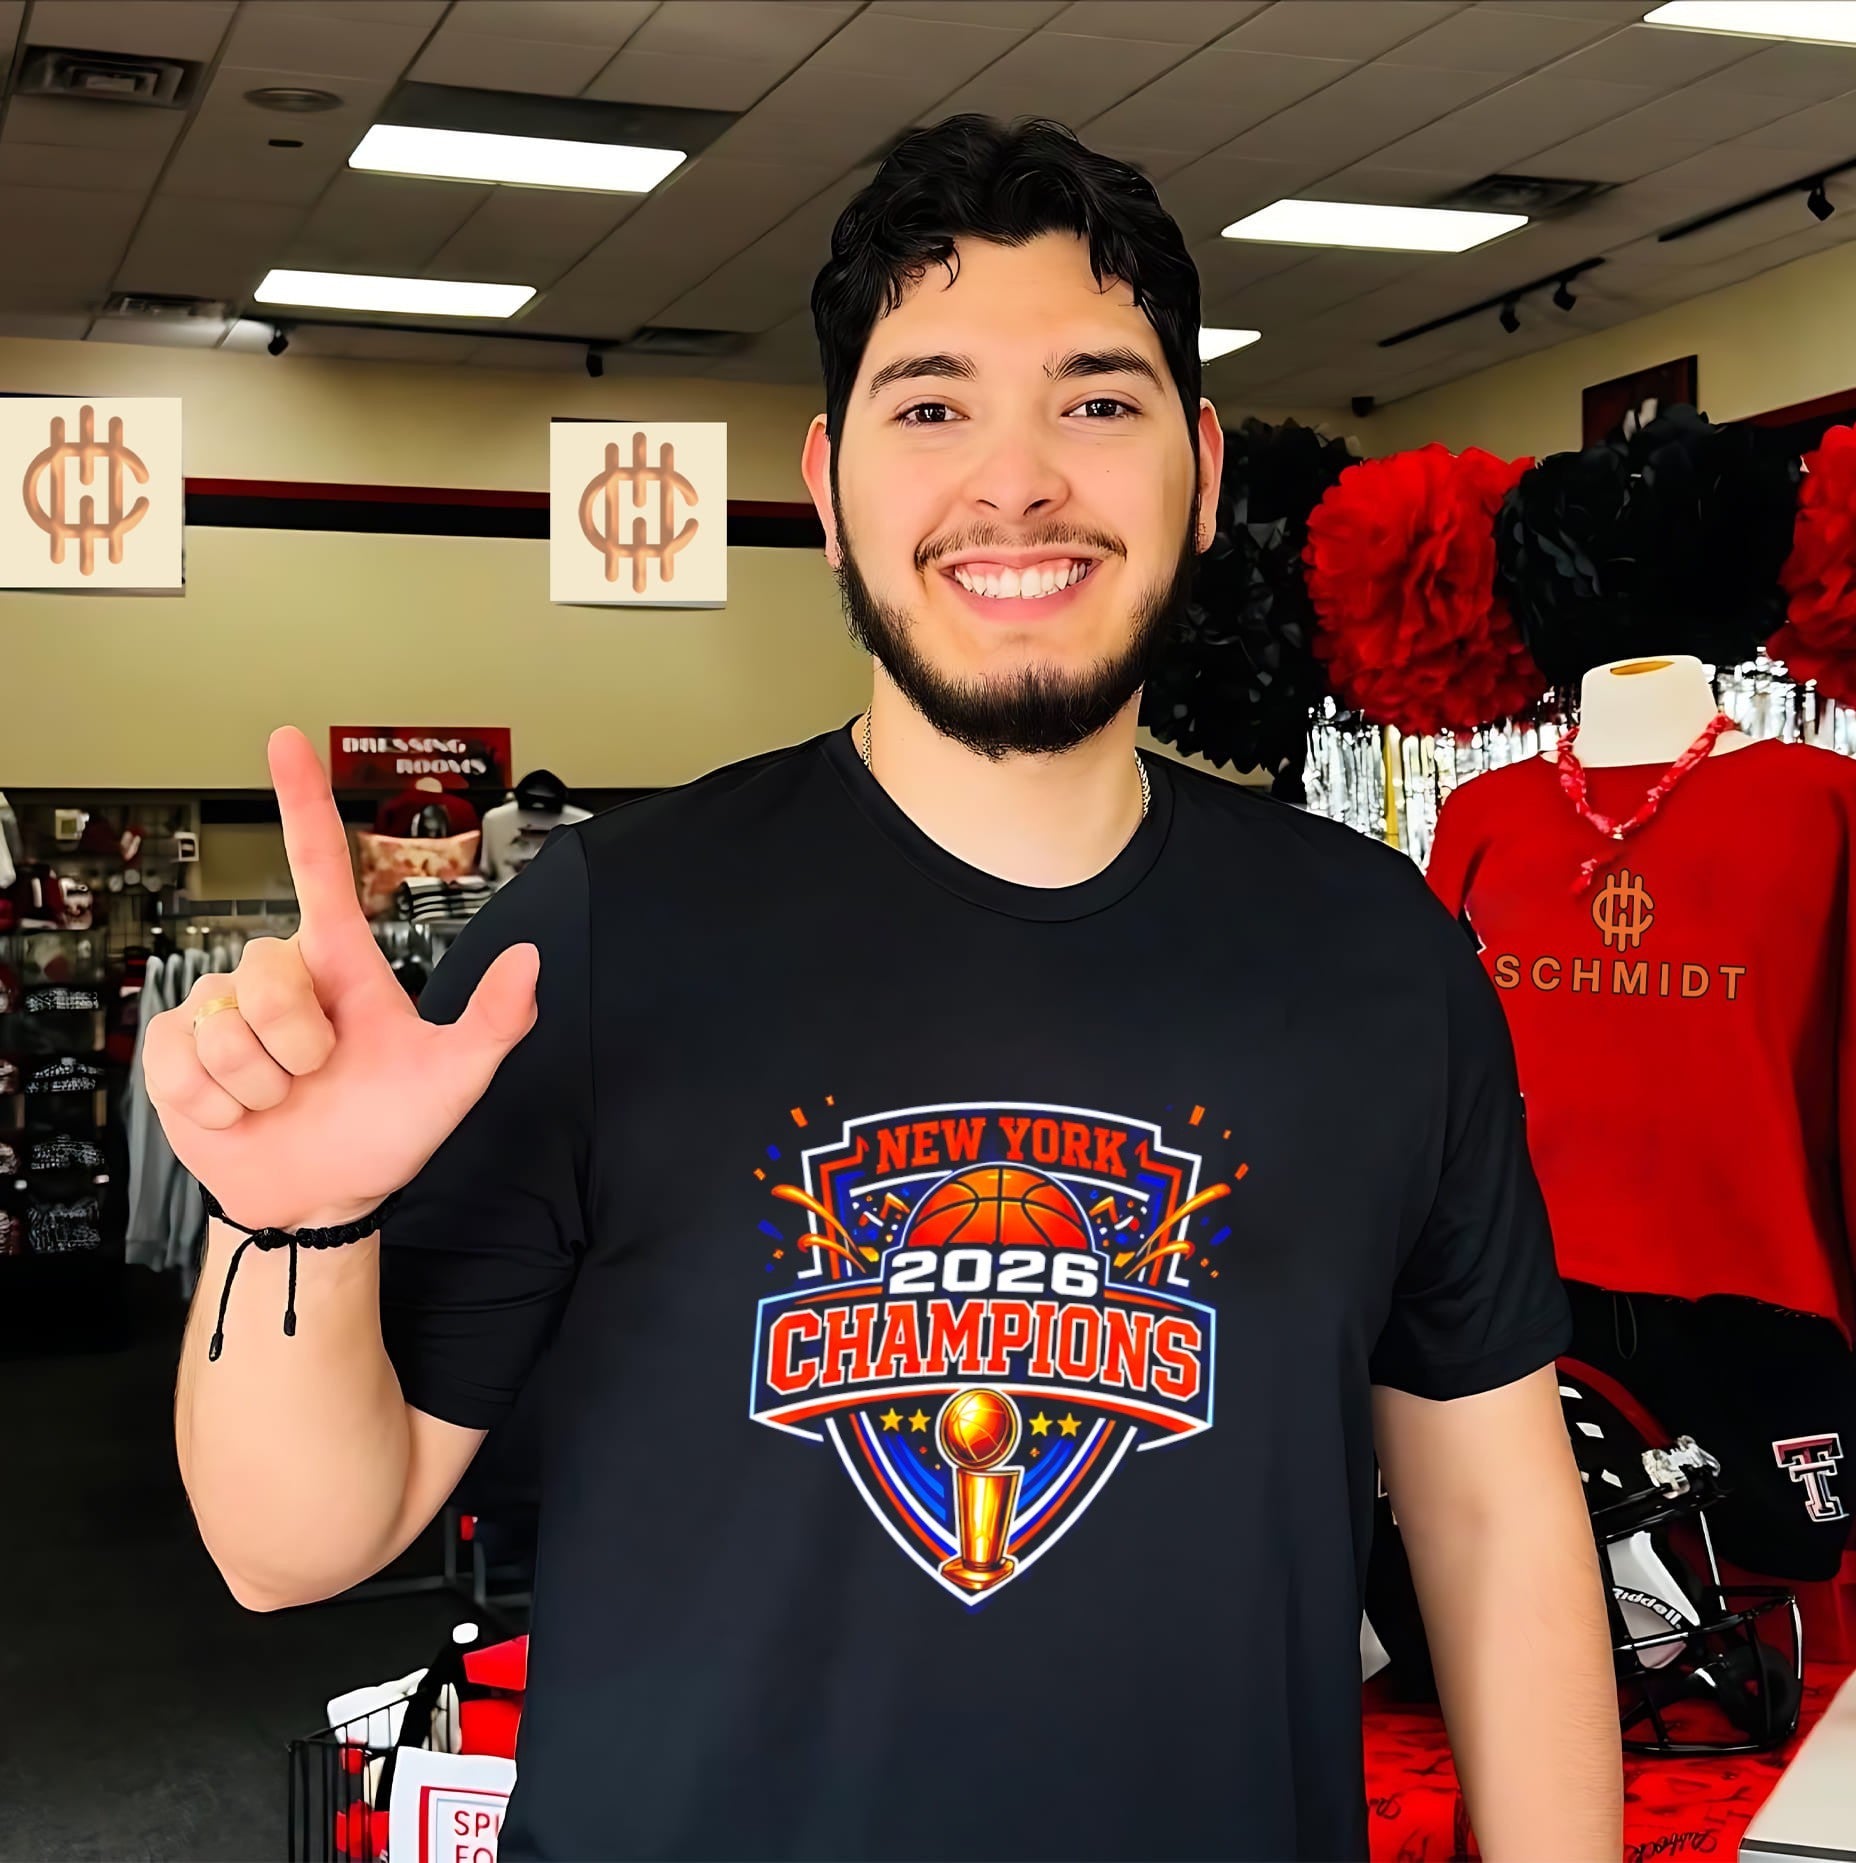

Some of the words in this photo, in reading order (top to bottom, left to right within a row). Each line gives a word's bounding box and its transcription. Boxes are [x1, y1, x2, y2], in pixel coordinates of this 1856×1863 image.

[1494, 954, 1747, 1000] SCHMIDT
[876, 1118, 987, 1174] NEW
[999, 1117, 1128, 1177] YORK
[889, 1249, 1100, 1298] 2026
[766, 1299, 1202, 1402] CHAMPIONS
